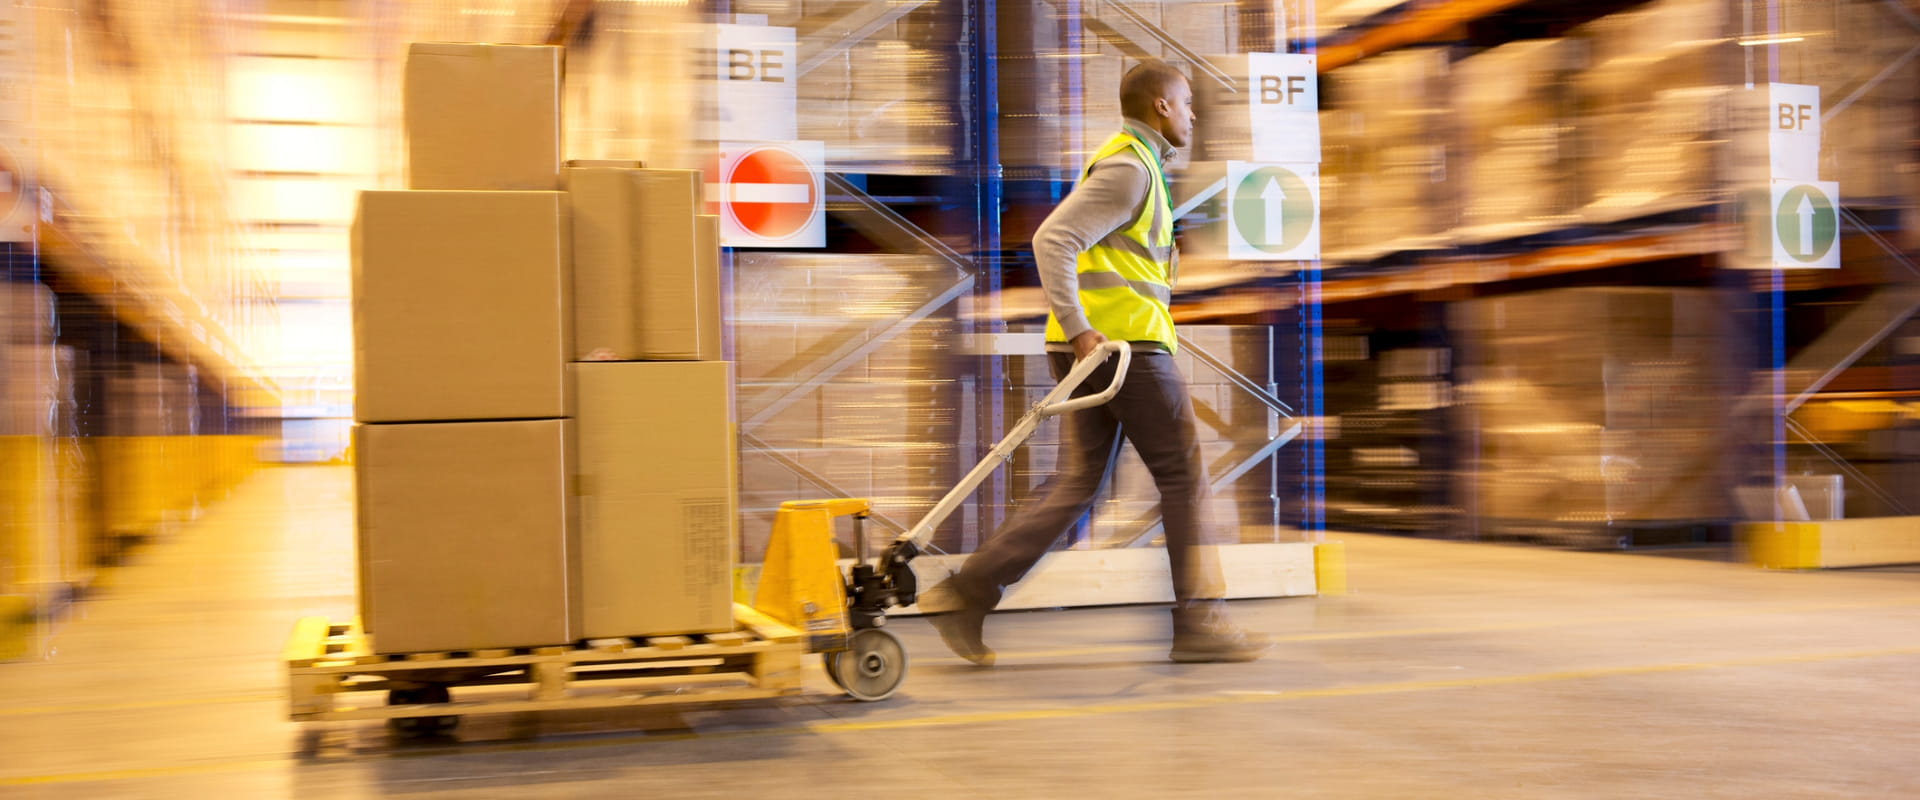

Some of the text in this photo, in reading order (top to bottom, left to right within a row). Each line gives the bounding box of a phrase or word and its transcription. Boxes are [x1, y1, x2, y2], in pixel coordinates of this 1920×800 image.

[728, 48, 785, 83] BE
[1260, 75, 1306, 105] BF
[1778, 103, 1812, 131] BF
